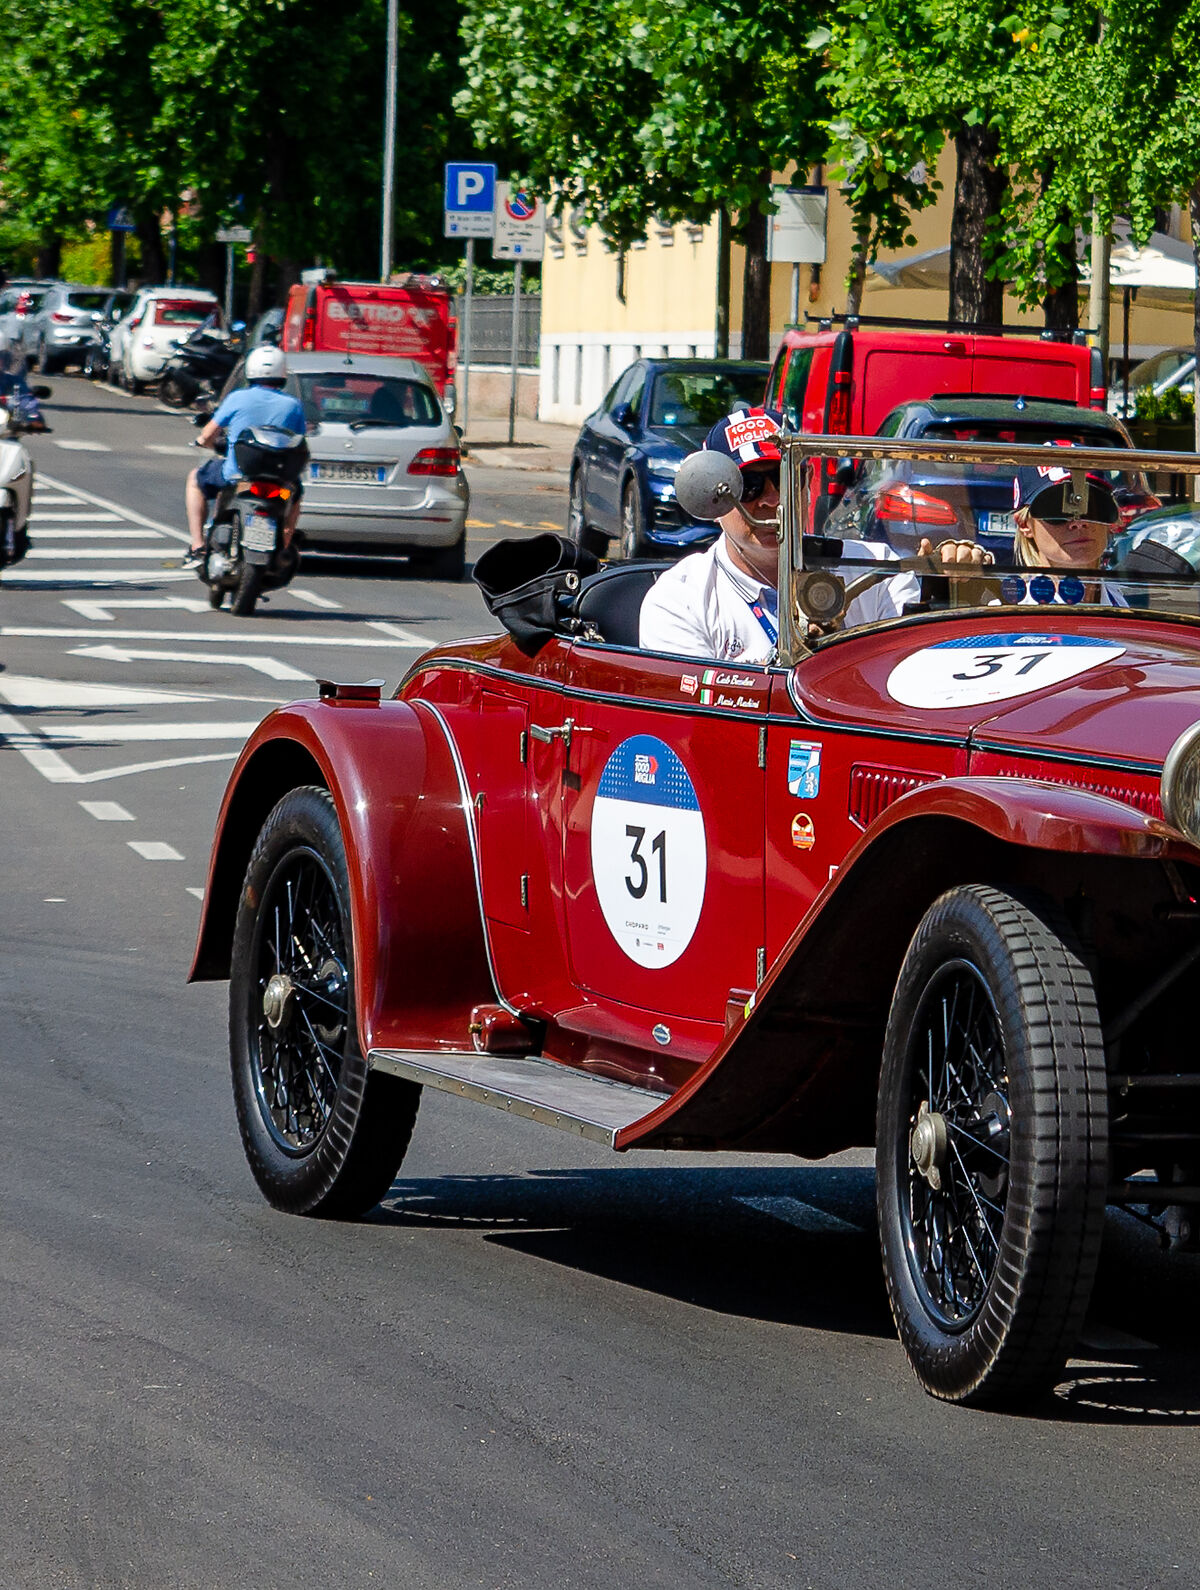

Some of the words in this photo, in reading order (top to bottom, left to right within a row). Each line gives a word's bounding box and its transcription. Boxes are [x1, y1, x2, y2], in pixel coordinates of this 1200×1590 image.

[458, 171, 484, 205] P
[731, 420, 766, 434] 1000
[952, 652, 1053, 680] 31
[635, 762, 650, 773] 1000
[625, 824, 667, 903] 31
